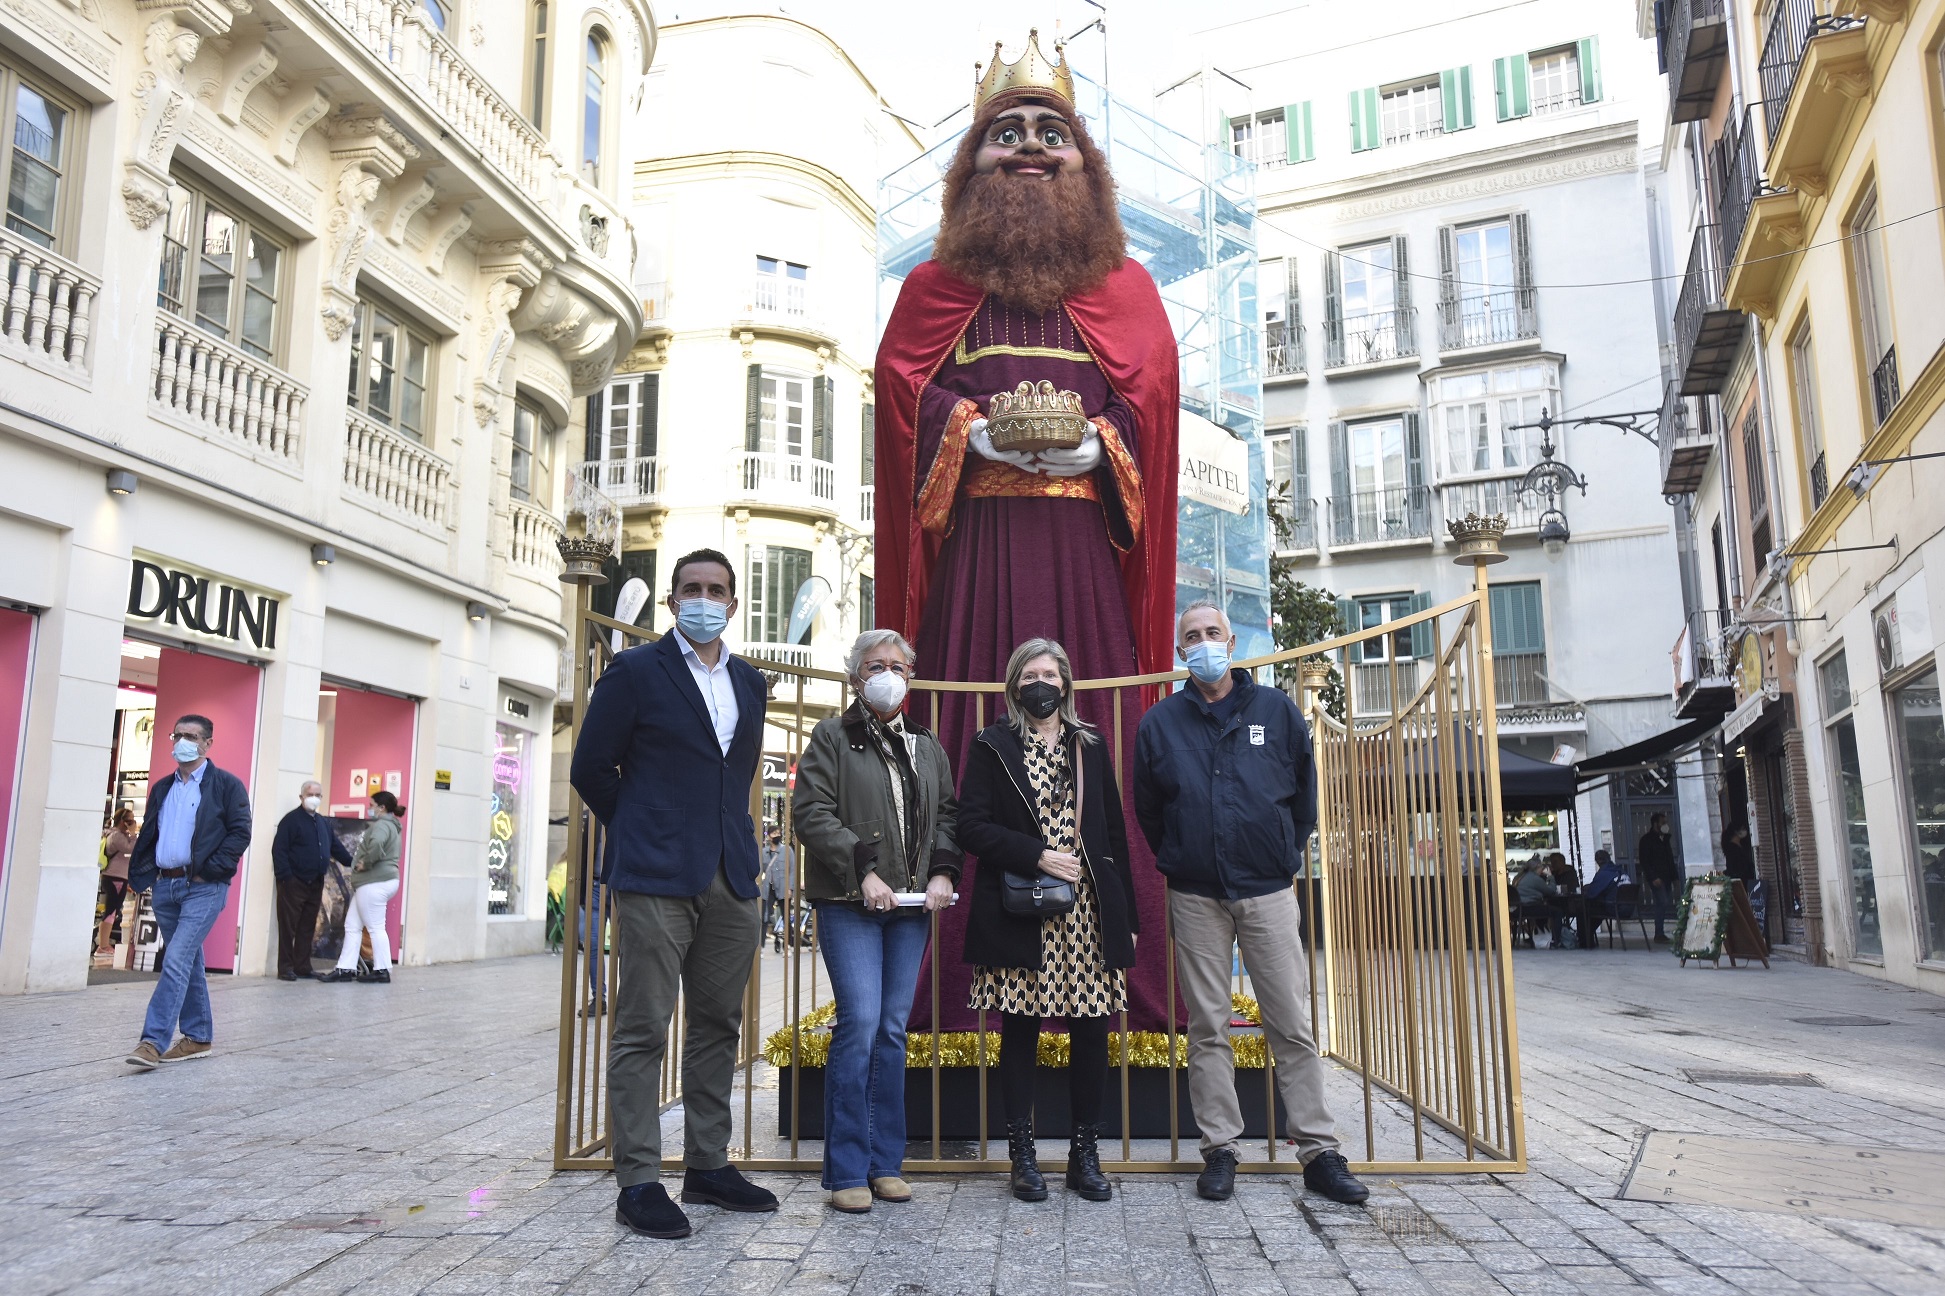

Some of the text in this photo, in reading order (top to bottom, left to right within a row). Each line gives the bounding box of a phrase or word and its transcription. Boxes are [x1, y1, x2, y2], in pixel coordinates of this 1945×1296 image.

[1178, 453, 1245, 496] APITEL
[126, 559, 279, 649] DRUNI
[494, 762, 512, 778] come
